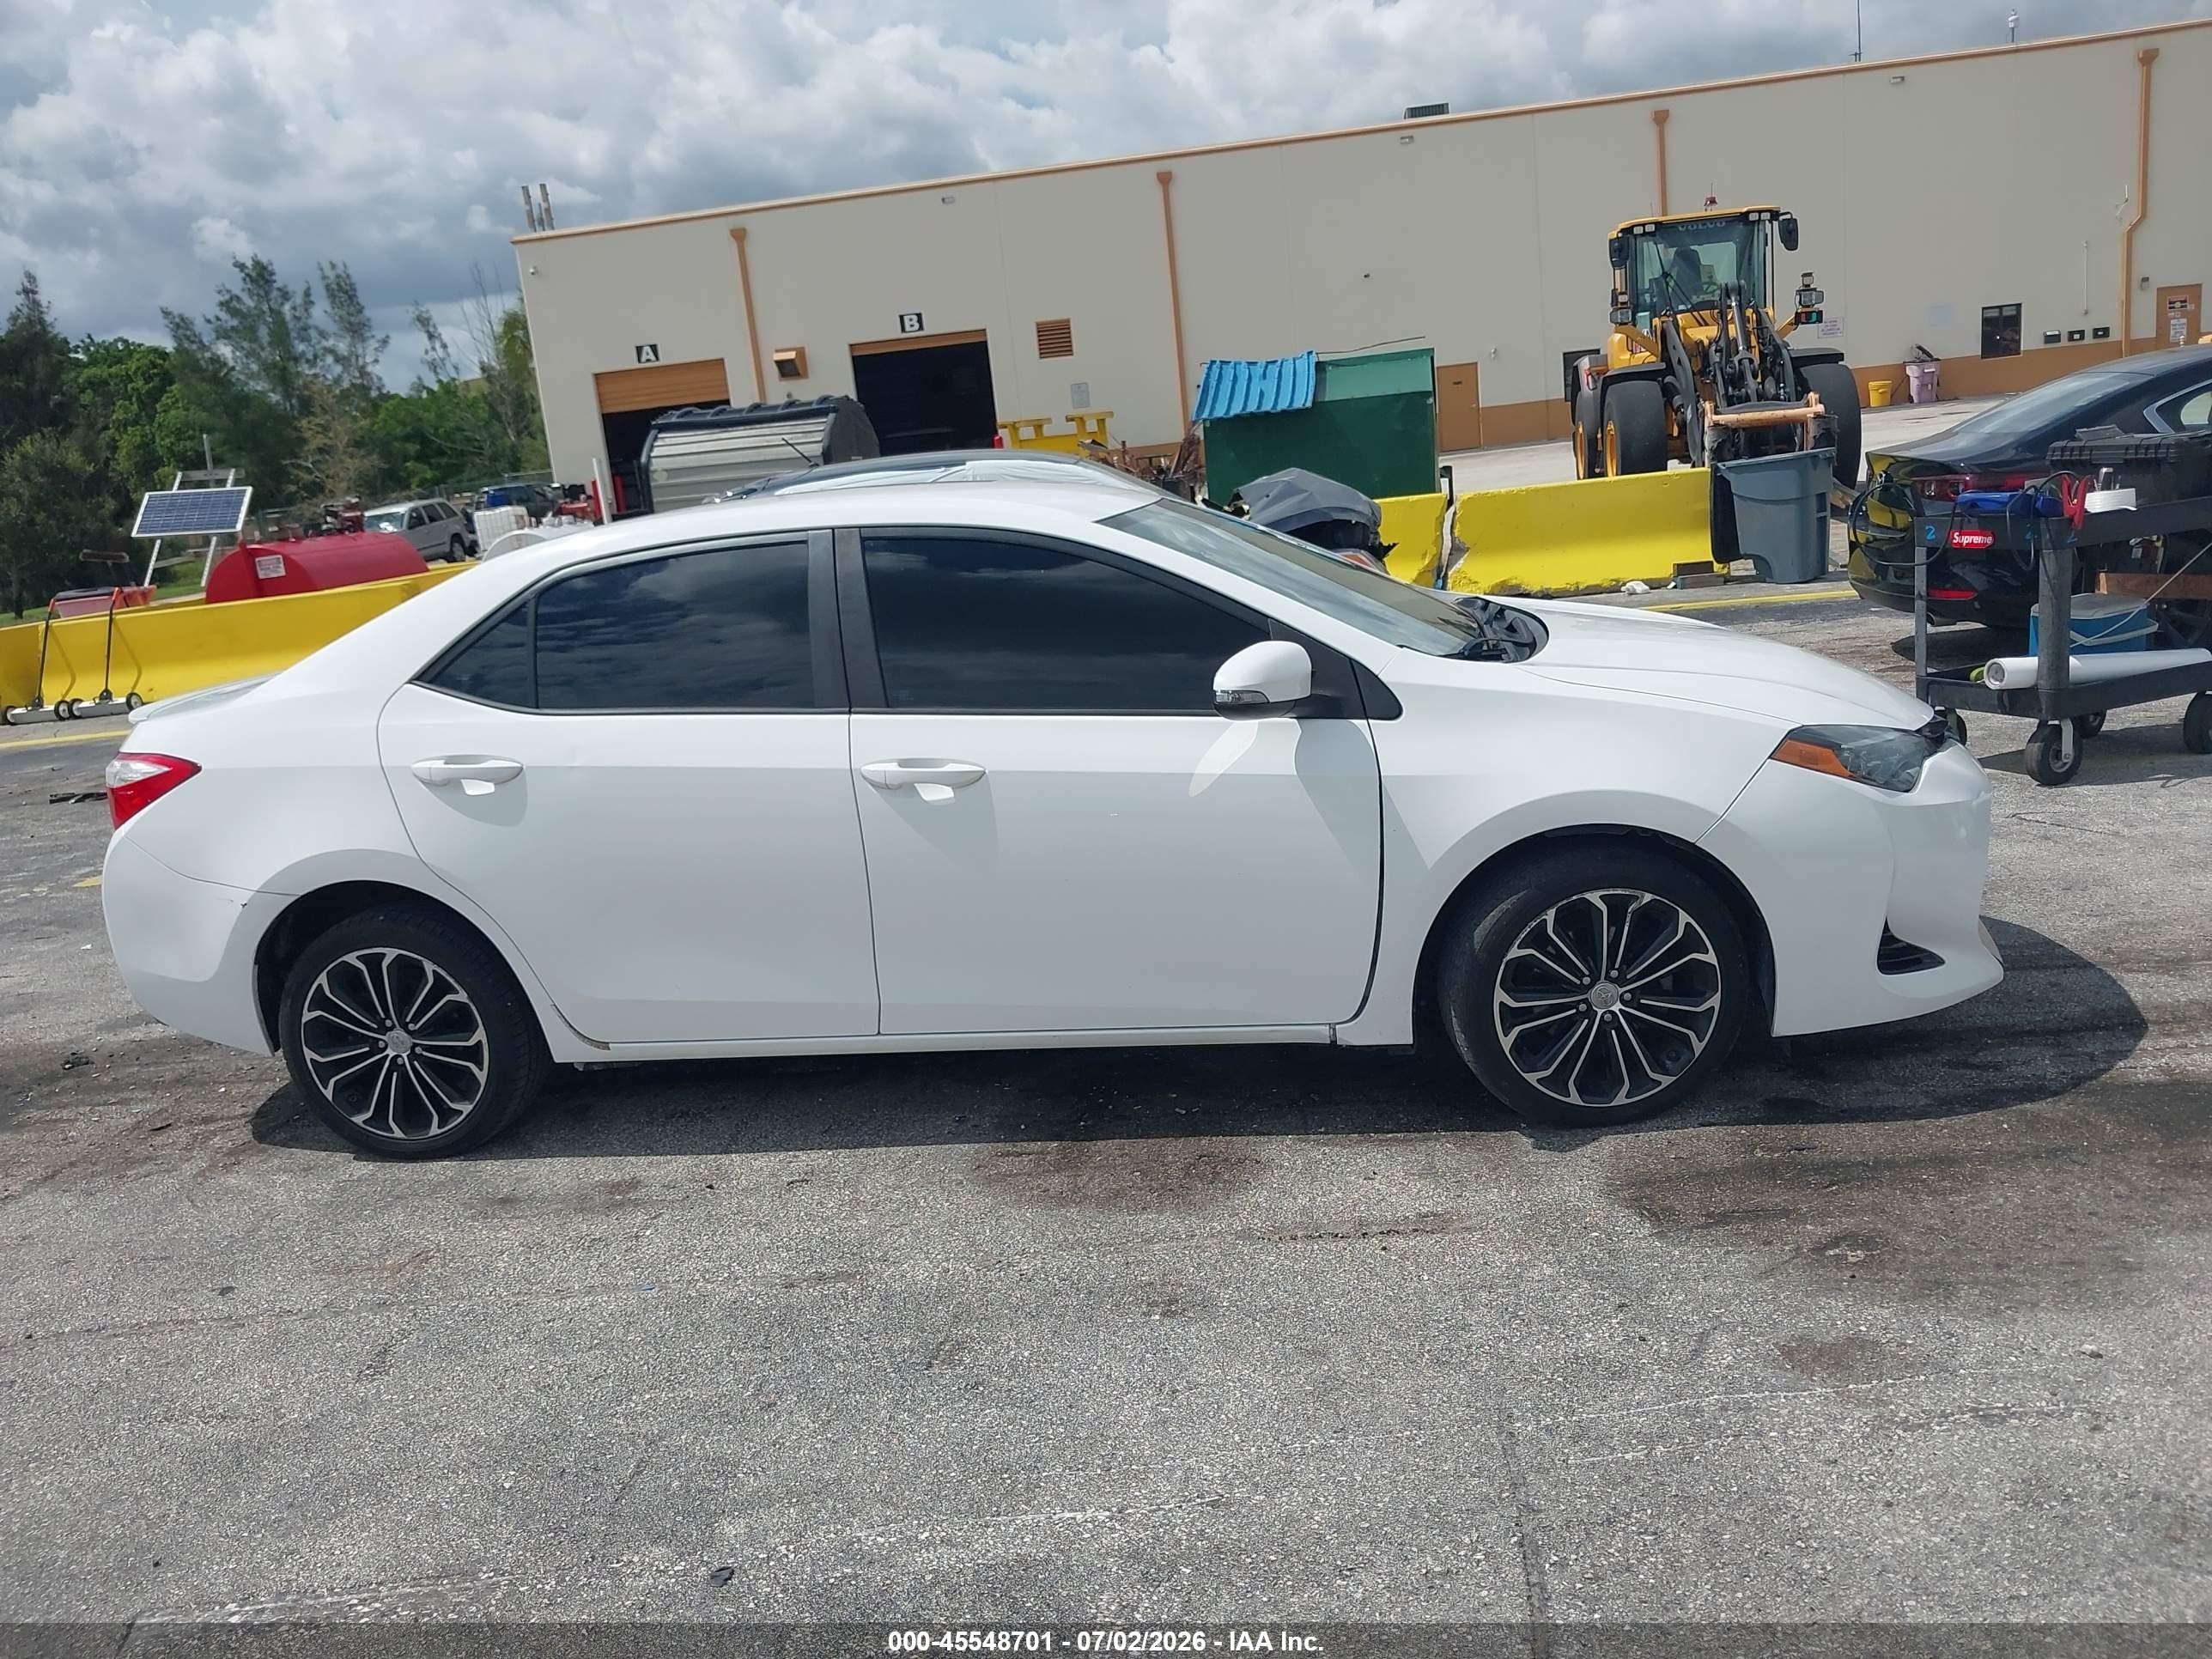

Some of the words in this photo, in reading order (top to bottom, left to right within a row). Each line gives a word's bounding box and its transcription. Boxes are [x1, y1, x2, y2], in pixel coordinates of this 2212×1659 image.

[902, 314, 920, 332] B
[640, 345, 657, 363] A
[1925, 525, 1936, 540] 2
[1952, 532, 1993, 547] Supreme
